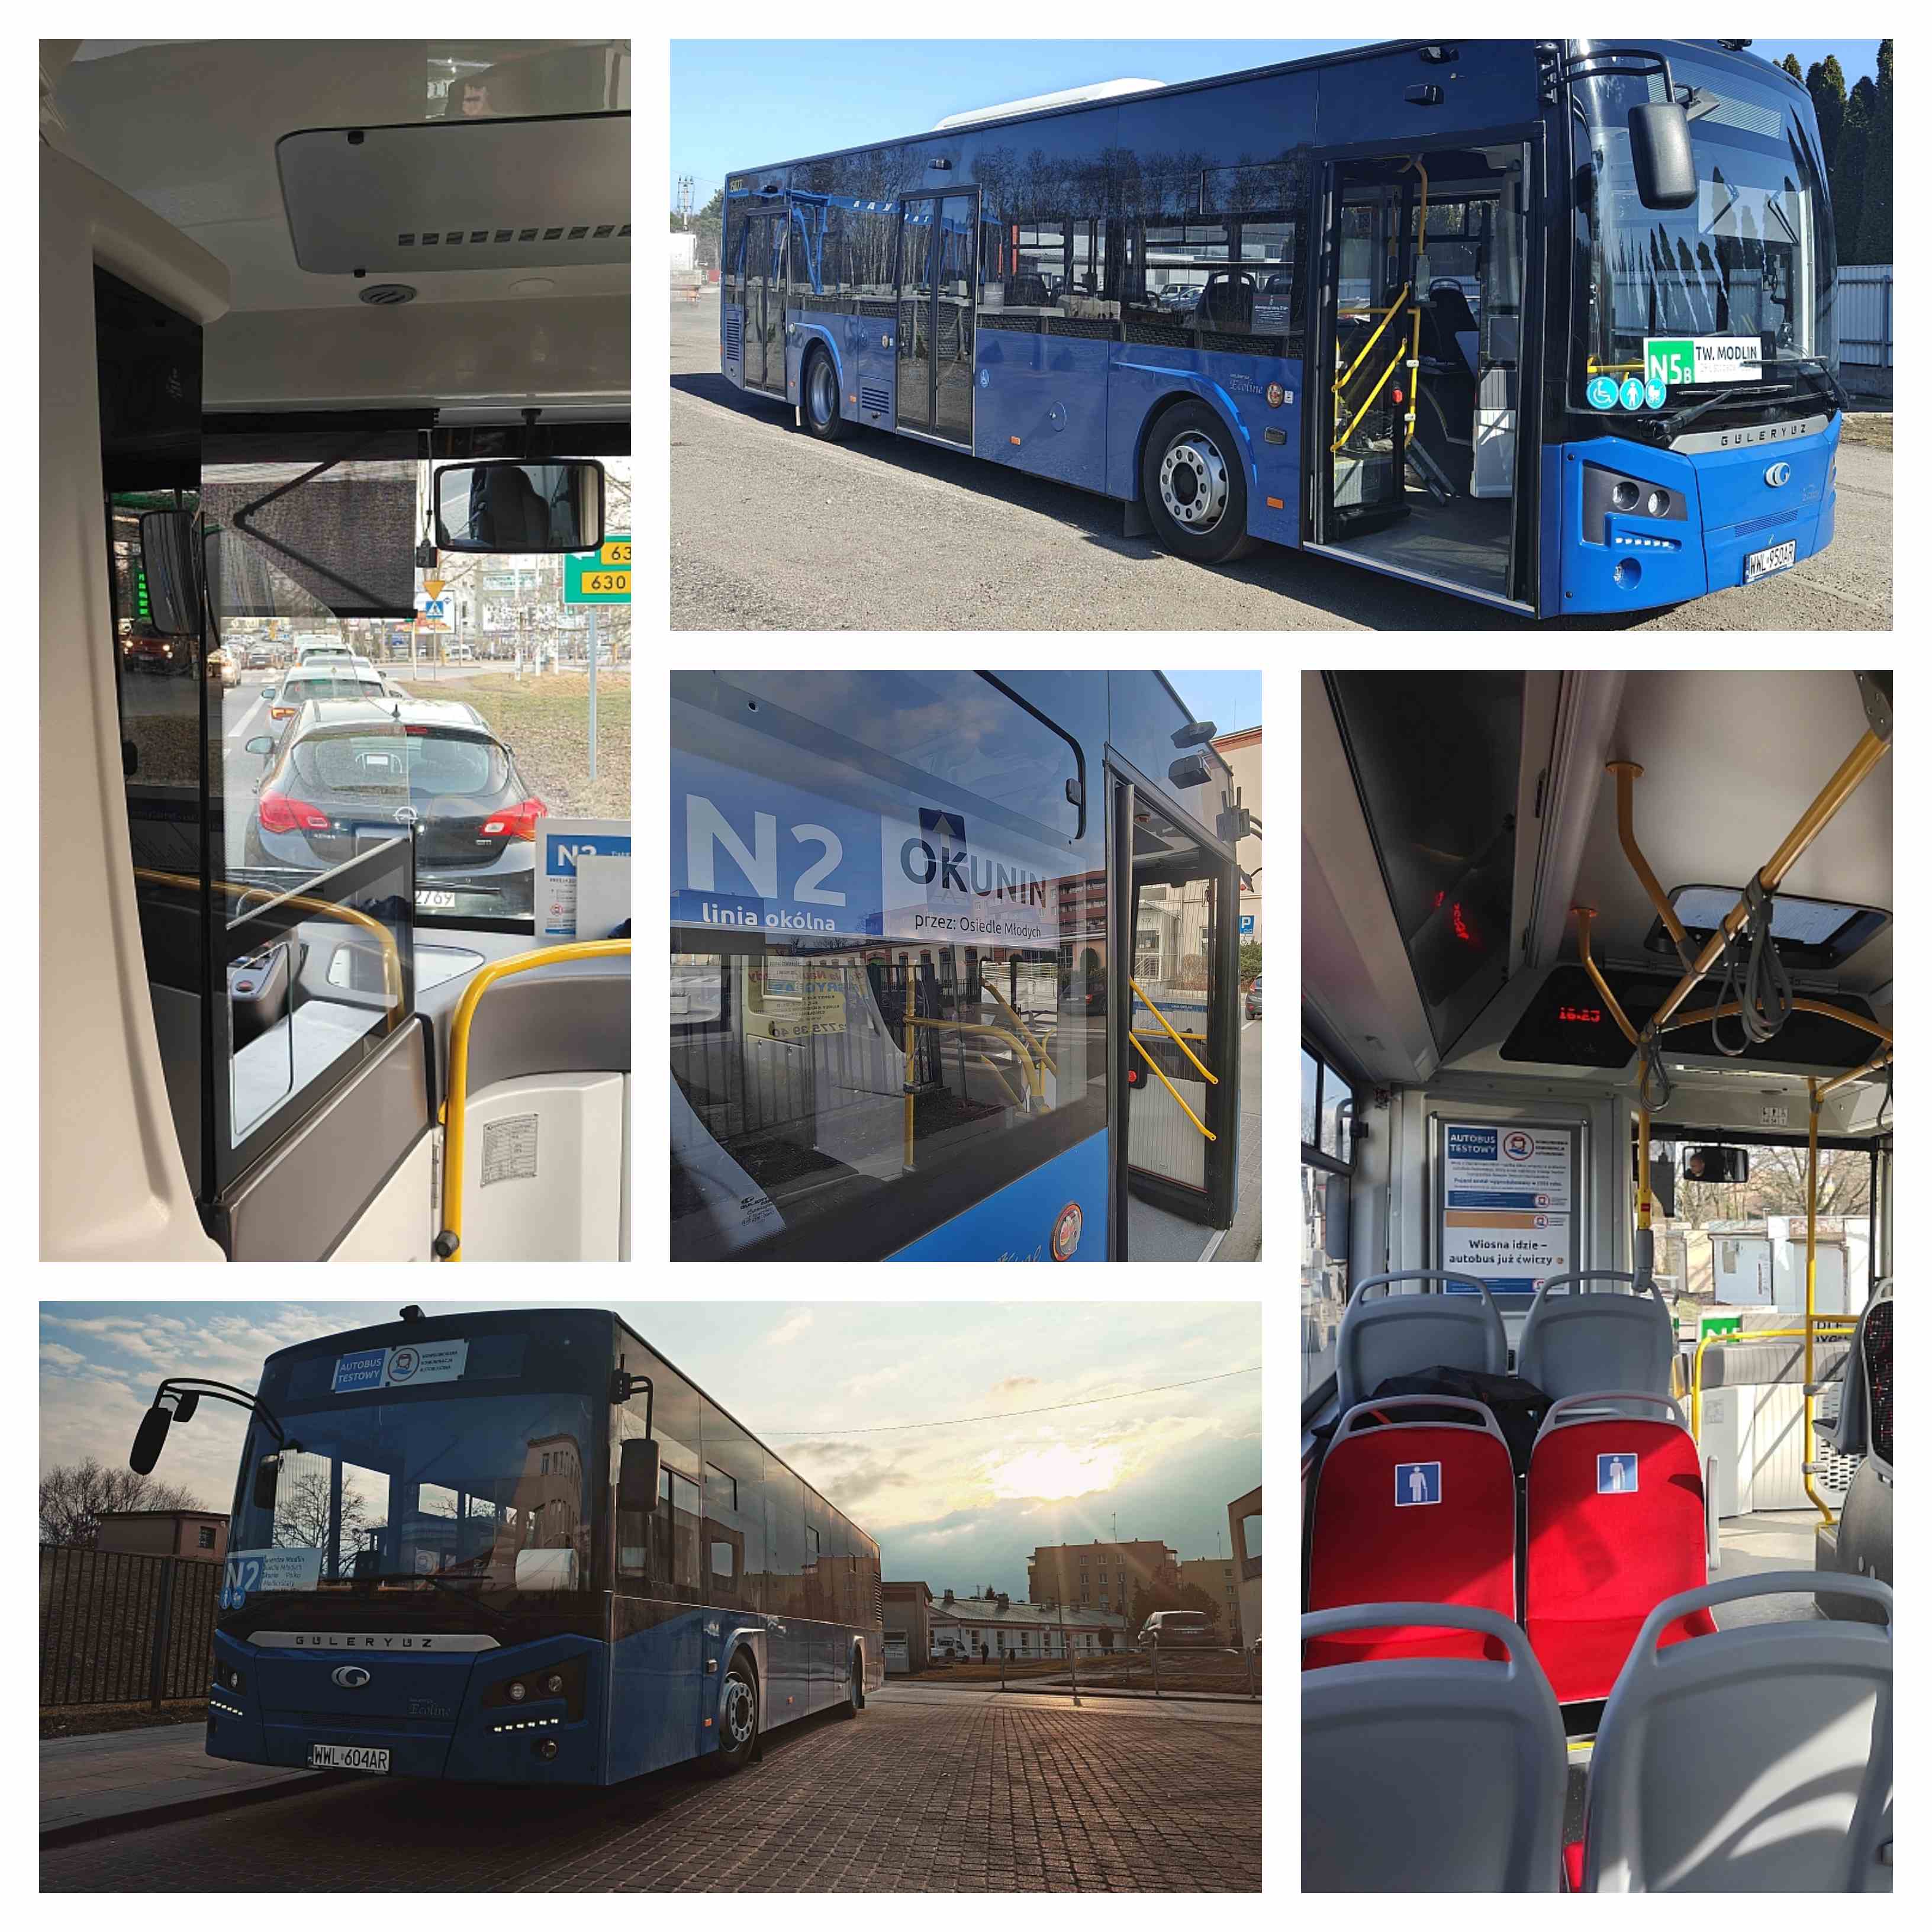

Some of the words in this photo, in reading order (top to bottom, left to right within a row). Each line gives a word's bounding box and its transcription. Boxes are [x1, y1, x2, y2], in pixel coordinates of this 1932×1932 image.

[1695, 346, 1715, 360] TW.
[1717, 346, 1757, 360] MODLIN
[591, 575, 626, 590] 630
[686, 793, 846, 907] N2
[900, 836, 1046, 910] OKUNIN
[701, 901, 758, 928] linia
[765, 909, 836, 932] okólna
[1241, 917, 1251, 929] P
[914, 912, 957, 934] przez:
[958, 916, 1003, 936] Osiedle
[1004, 920, 1042, 941] Młodych
[1450, 1134, 1496, 1144] AUTOBUS
[1449, 1144, 1496, 1154] TESTOWY
[1469, 1239, 1509, 1250] Wiosna
[1512, 1239, 1538, 1250] idzie
[1449, 1253, 1495, 1264] autobus
[1497, 1253, 1514, 1266] już
[1516, 1253, 1553, 1266] ćwiczy
[340, 1358, 382, 1371] AUTOBUS
[337, 1370, 379, 1383] TESTOWY
[225, 1560, 259, 1592] N2
[314, 1746, 339, 1766] WWL
[344, 1749, 388, 1769] 604AR
